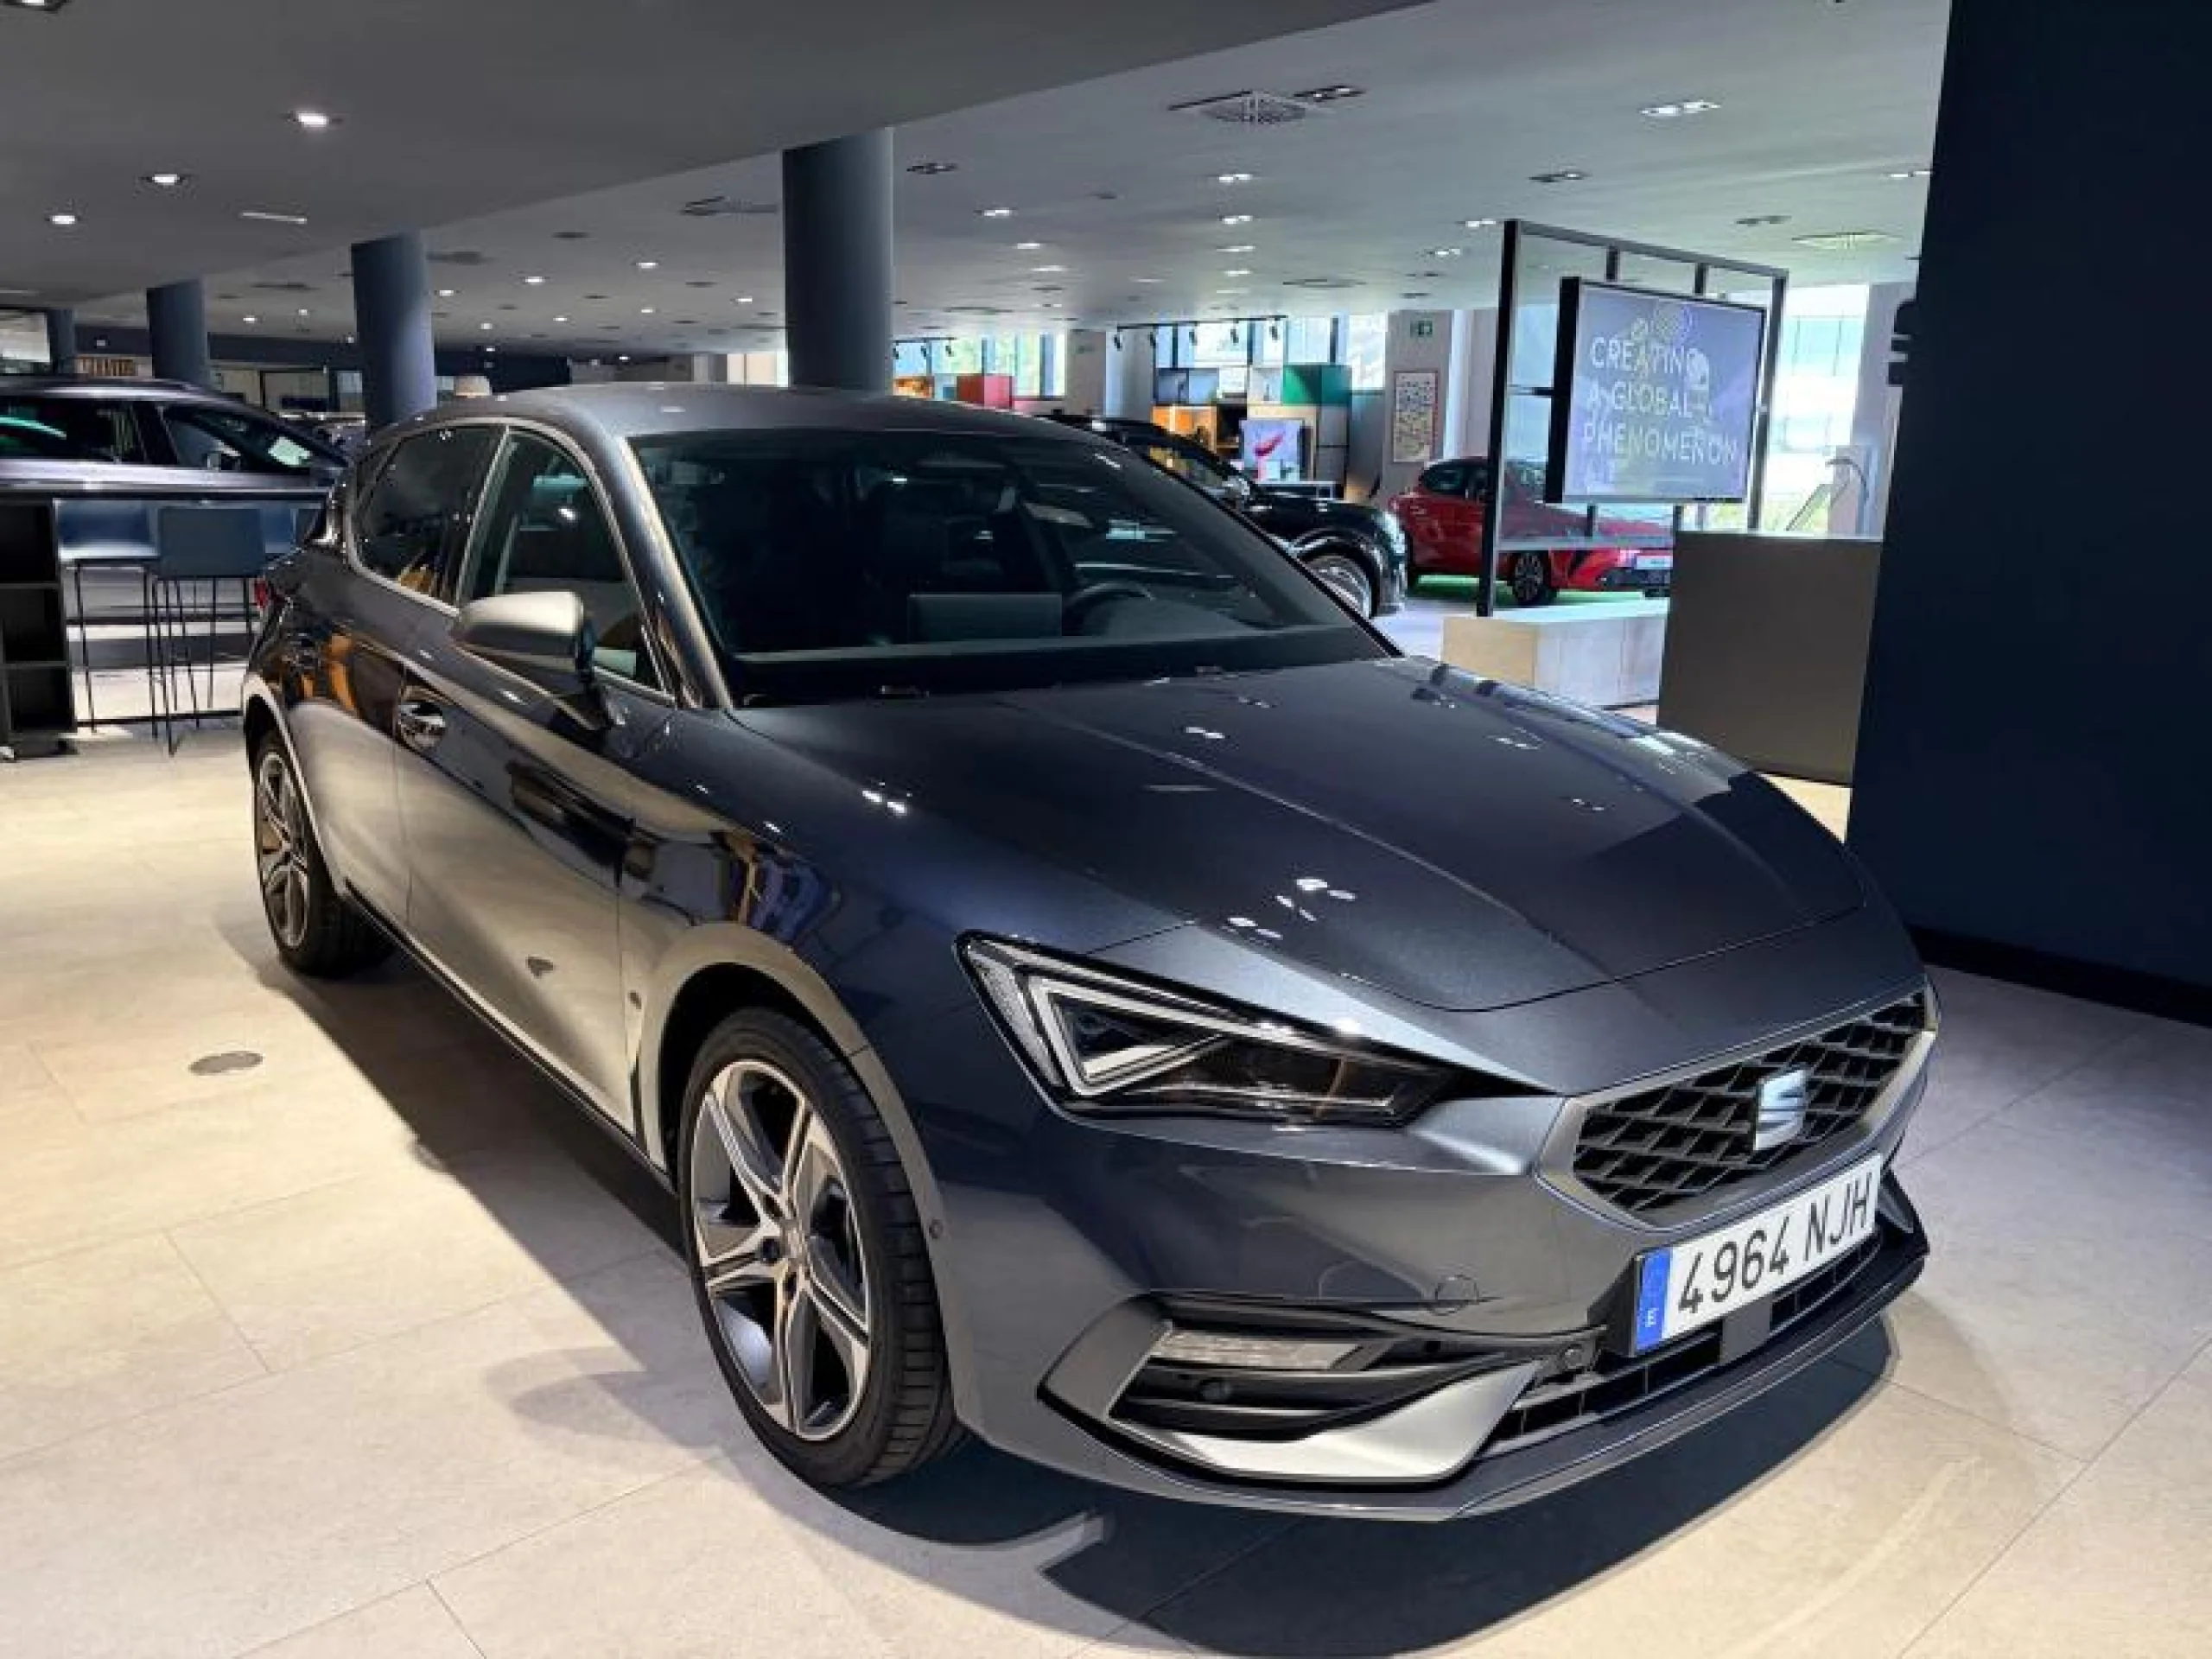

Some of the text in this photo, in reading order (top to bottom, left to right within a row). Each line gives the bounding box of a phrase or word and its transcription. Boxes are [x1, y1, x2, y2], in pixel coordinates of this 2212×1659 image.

[1611, 381, 1693, 419] GLOBAL
[1583, 422, 1738, 466] PHENOMENON
[1676, 1172, 1873, 1314] 4964 NJH
[1645, 1307, 1658, 1327] E
